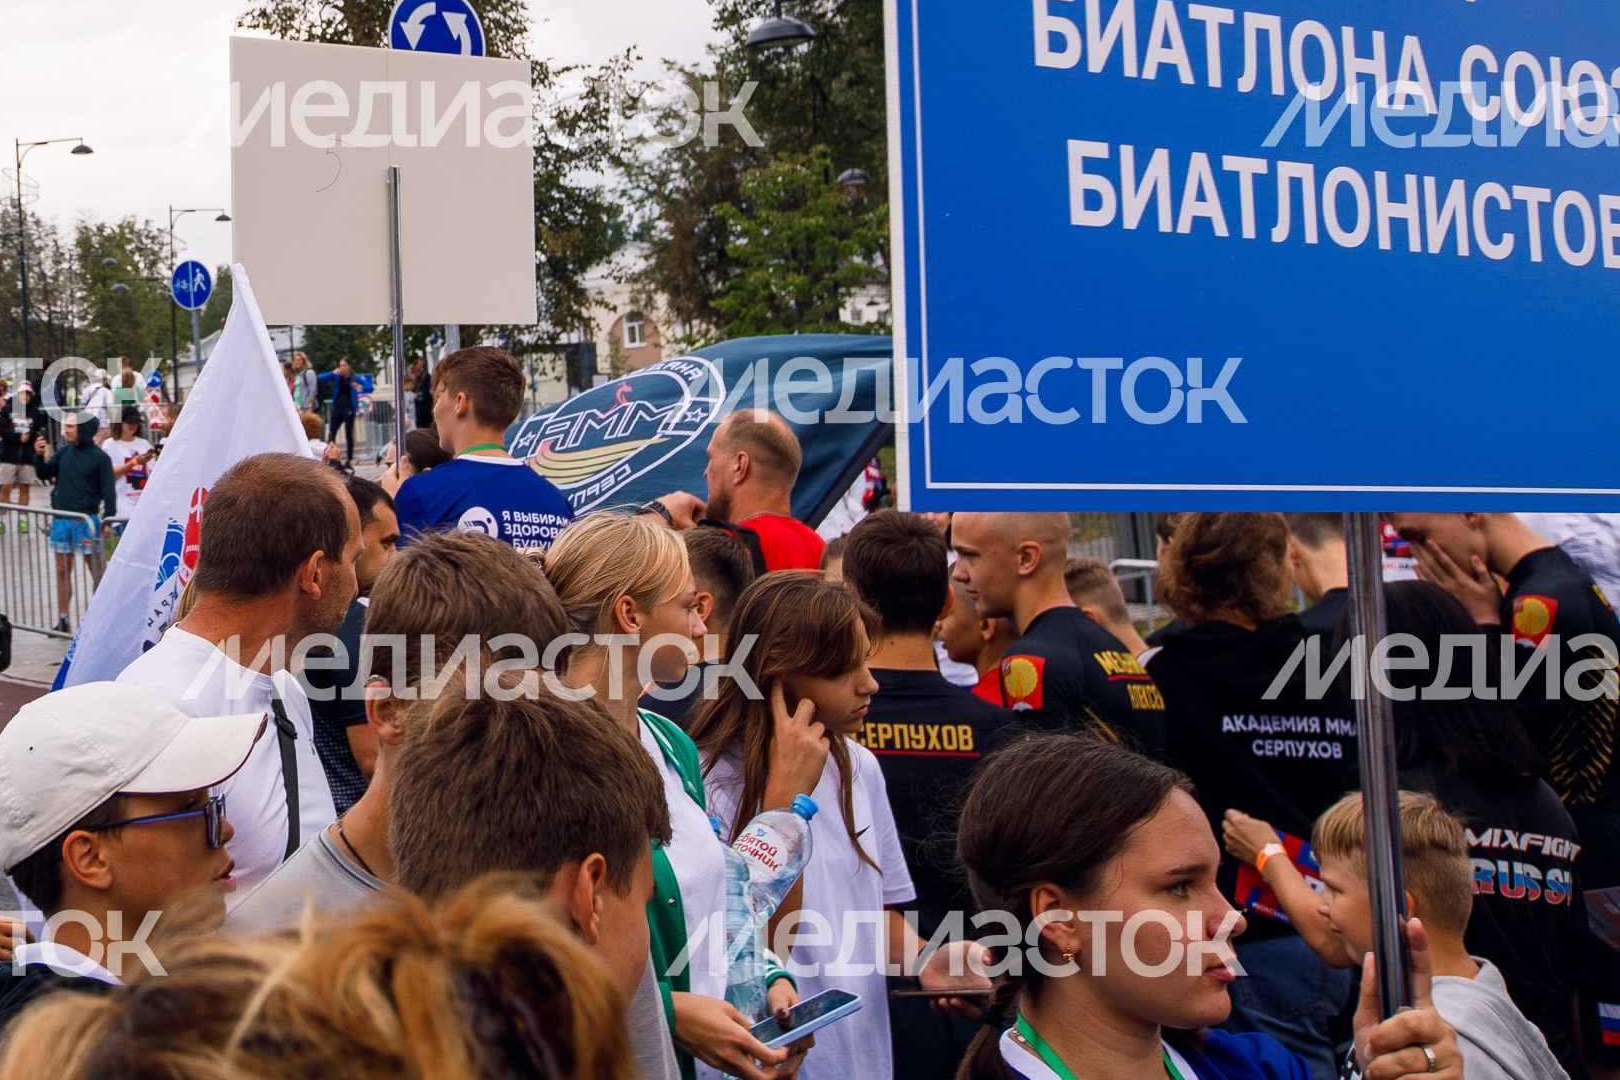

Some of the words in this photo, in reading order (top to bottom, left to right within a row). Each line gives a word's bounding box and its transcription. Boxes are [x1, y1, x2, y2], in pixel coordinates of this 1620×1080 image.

[502, 510, 511, 521] Я
[513, 511, 568, 527] ВЫБИРА
[504, 523, 564, 539] ЗДОРОВ
[512, 538, 552, 550] БУДУ
[1222, 715, 1321, 734] АКАДЕМИЯ
[856, 723, 974, 751] СЕРПУХОВ
[1251, 739, 1343, 759] СЕРПУХОВ
[1471, 857, 1573, 906] RUSSI
